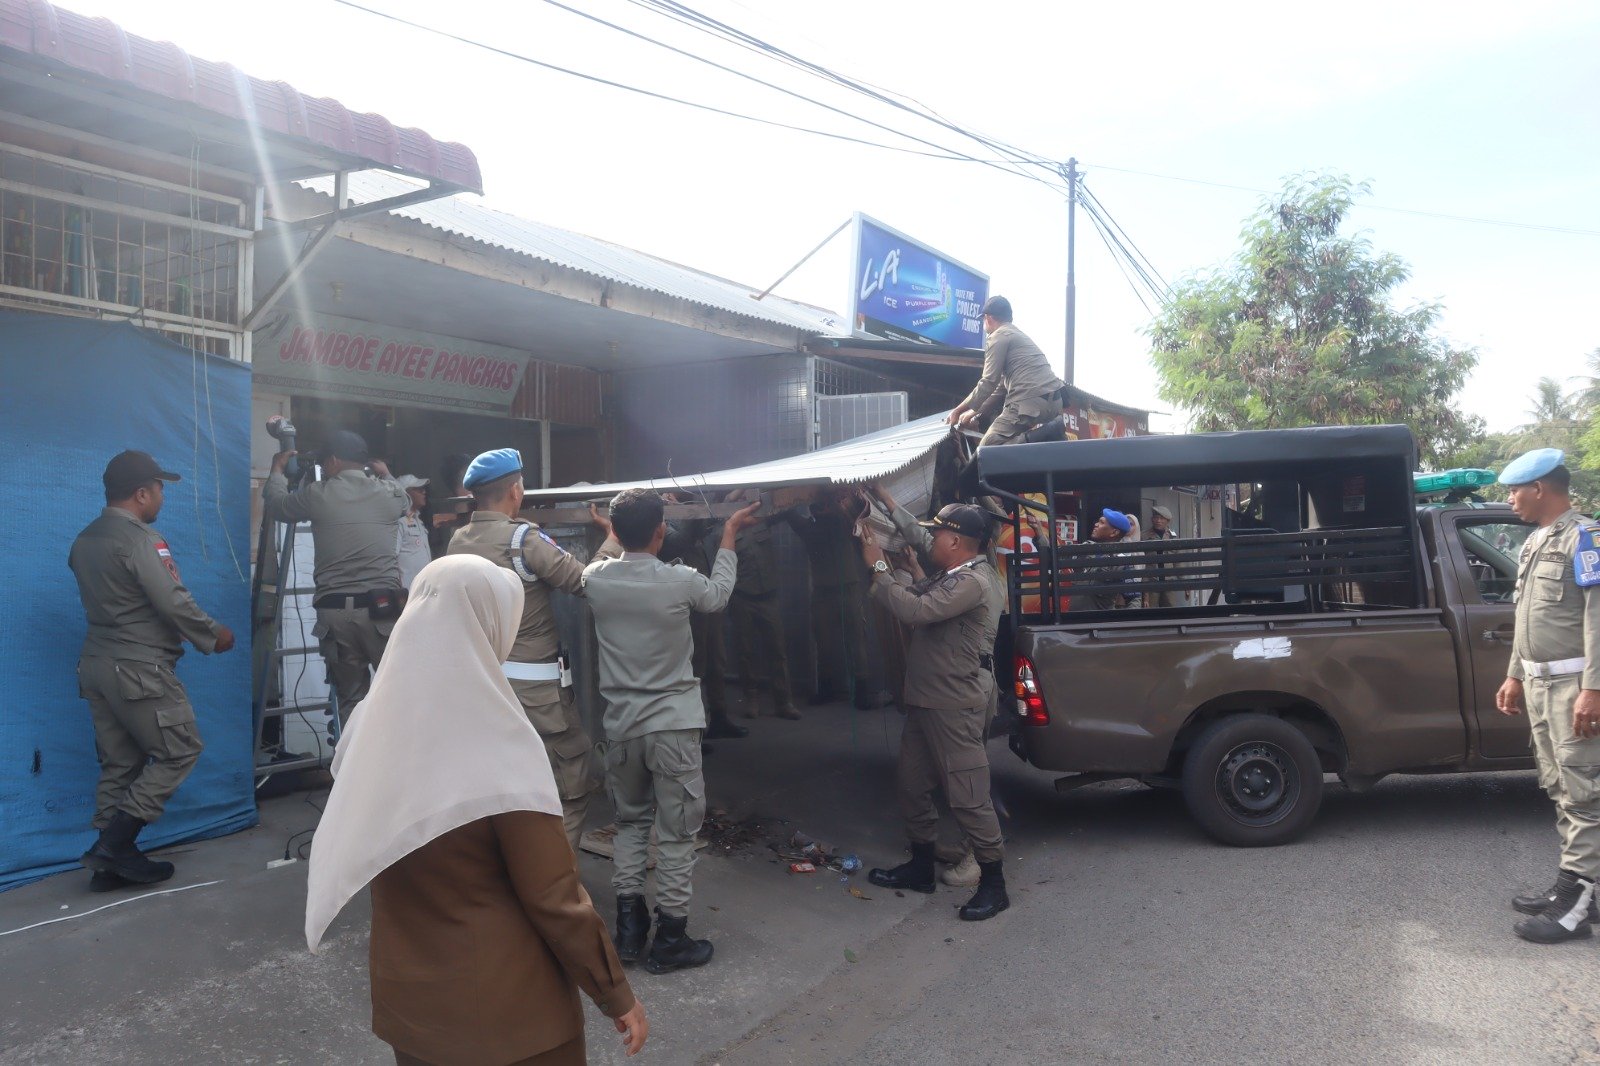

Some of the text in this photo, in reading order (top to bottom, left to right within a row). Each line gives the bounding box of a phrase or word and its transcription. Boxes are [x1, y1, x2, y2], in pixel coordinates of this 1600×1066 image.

[883, 296, 897, 308] ICE
[956, 300, 981, 319] COOLEST
[280, 327, 380, 371] JAMBOE
[376, 342, 434, 379] AYEE
